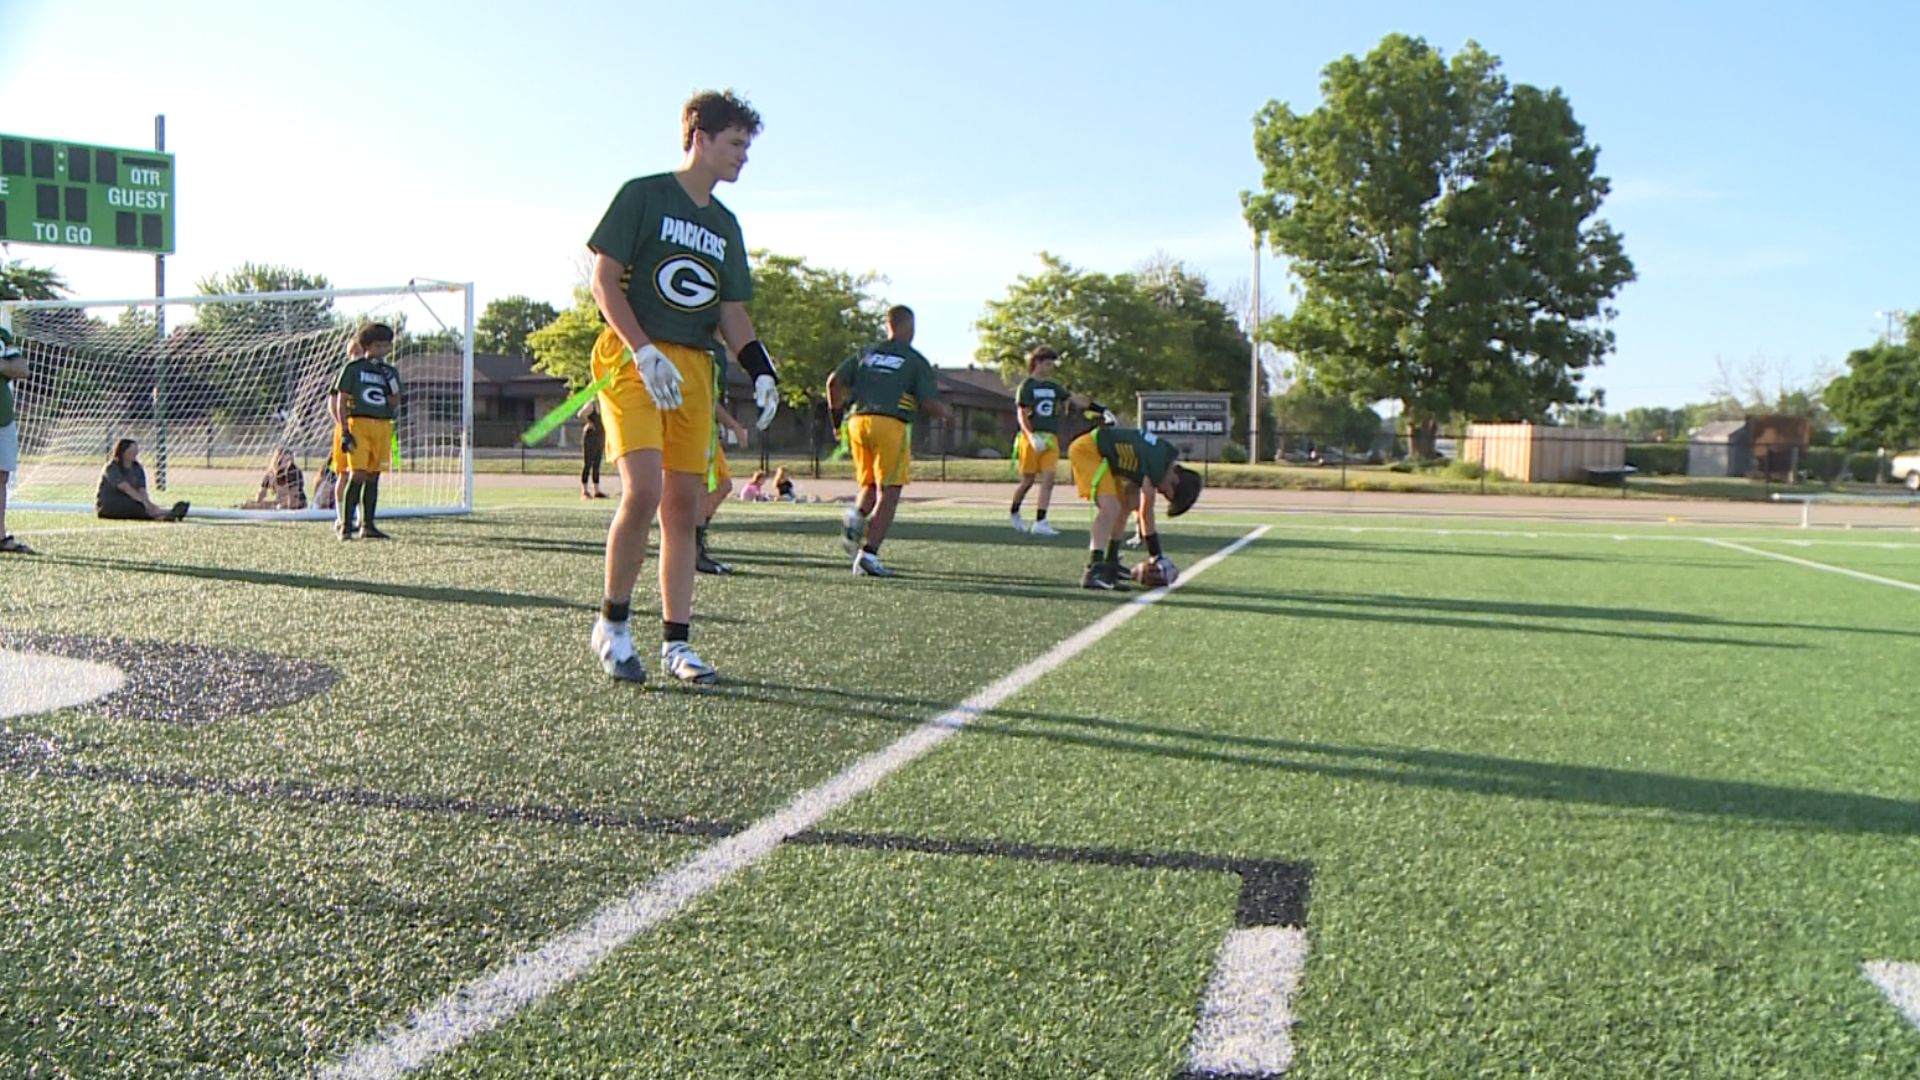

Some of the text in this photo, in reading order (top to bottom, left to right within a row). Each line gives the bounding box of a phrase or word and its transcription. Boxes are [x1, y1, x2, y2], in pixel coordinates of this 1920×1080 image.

[131, 168, 161, 186] QTR
[108, 187, 169, 210] GUEST
[32, 222, 93, 245] TO GO
[660, 215, 727, 262] PACKERS
[657, 257, 718, 309] G
